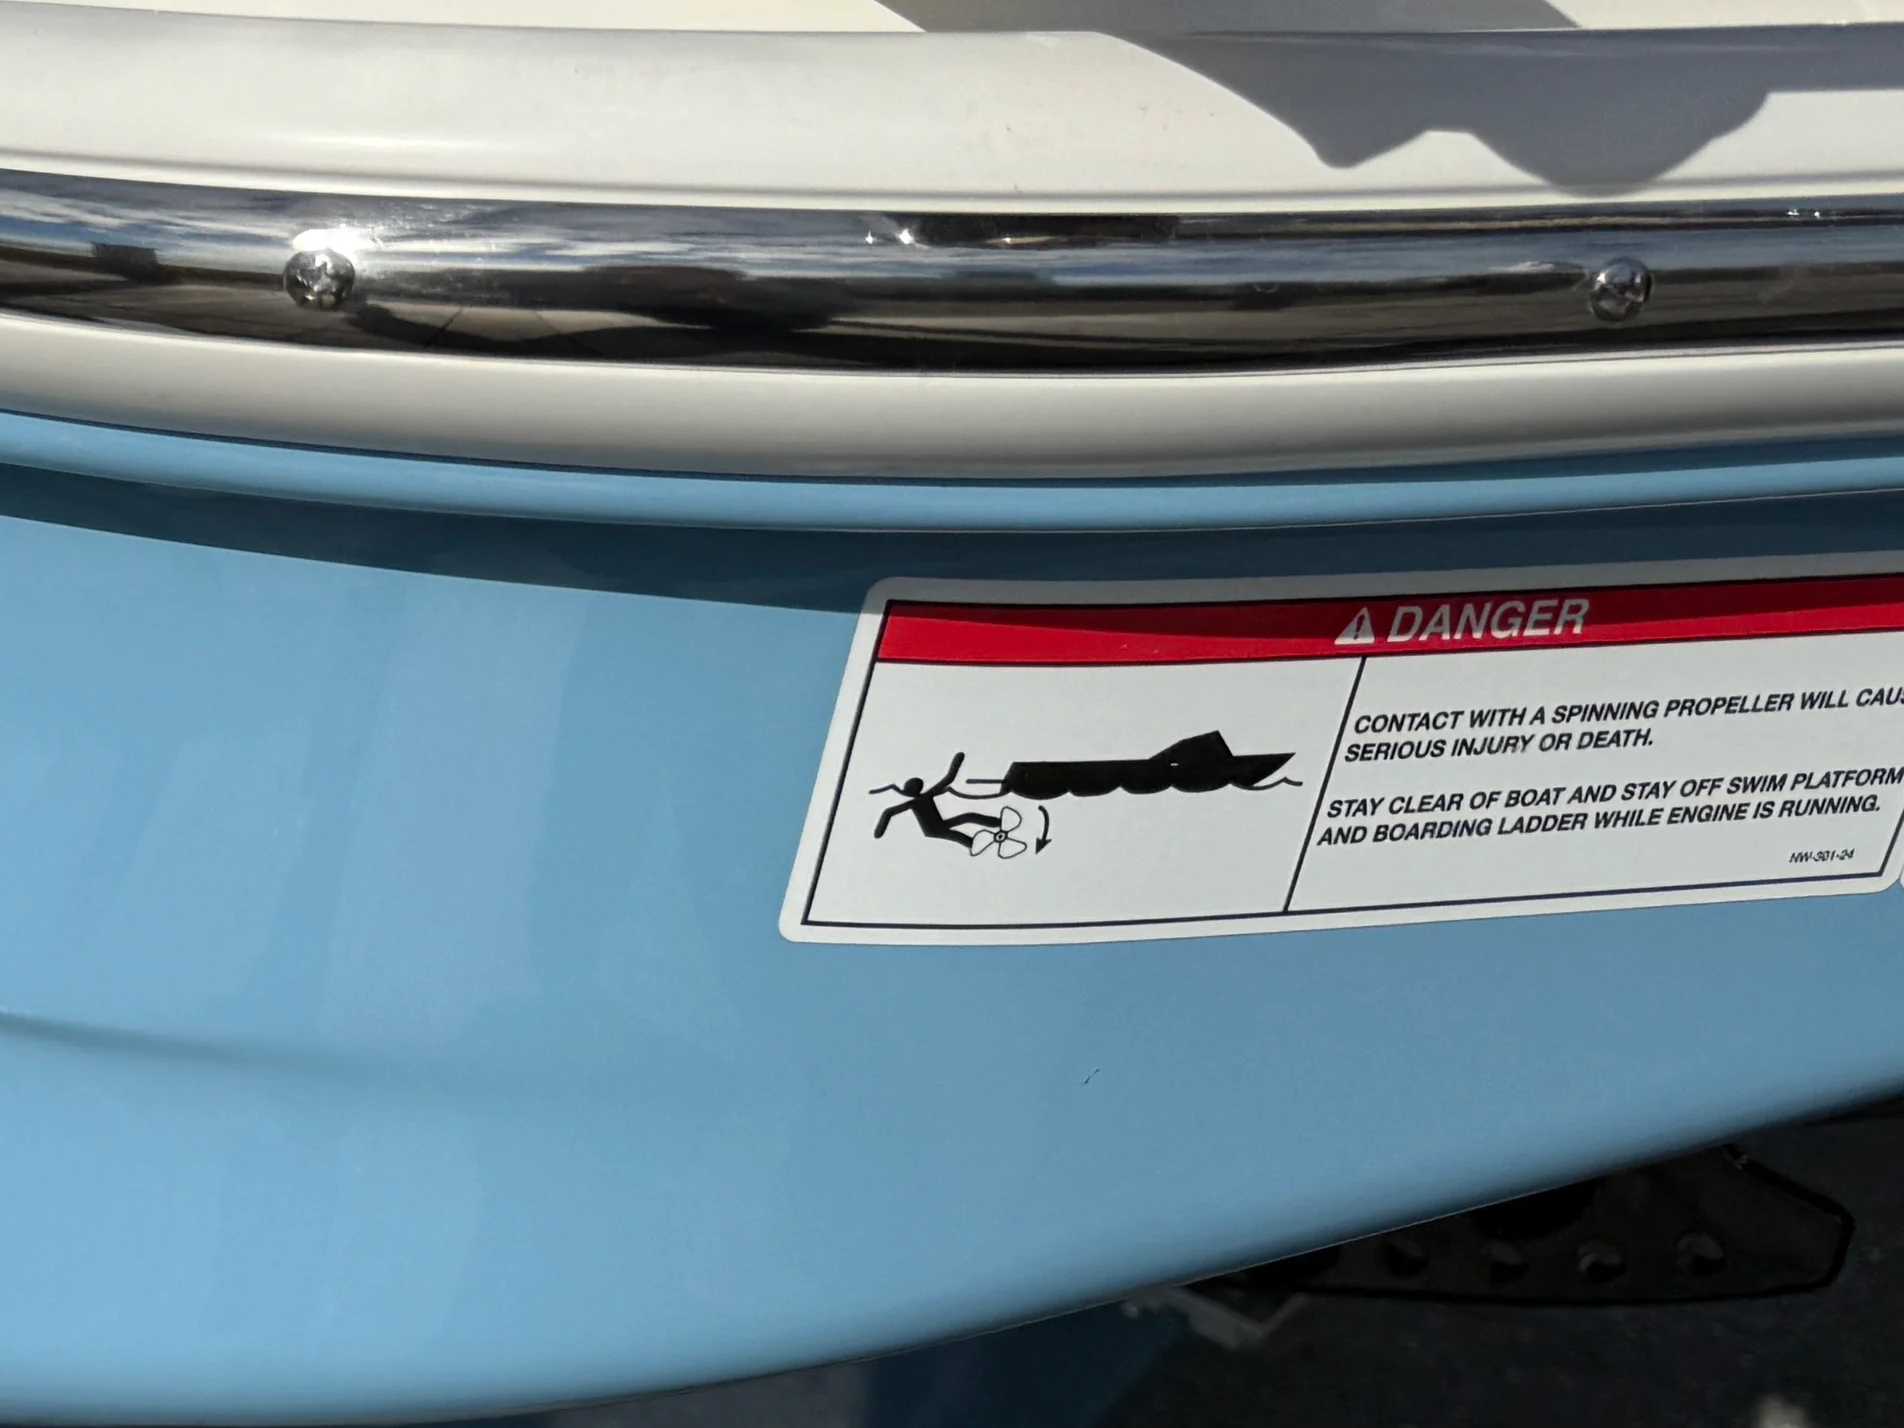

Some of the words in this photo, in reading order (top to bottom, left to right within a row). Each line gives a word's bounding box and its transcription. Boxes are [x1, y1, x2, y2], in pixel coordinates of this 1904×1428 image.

[1387, 598, 1590, 643] DANGER
[1354, 711, 1465, 734] CONTACT
[1469, 707, 1526, 728] WITH
[1530, 705, 1546, 725] A
[1551, 701, 1659, 723] SPINNING
[1663, 693, 1795, 718] PROPELLER
[1799, 690, 1849, 710] WILL
[1856, 685, 1904, 707] CAU
[1344, 739, 1446, 762] SERIOUS
[1451, 733, 1535, 757] INJURY
[1538, 732, 1572, 752] OR
[1577, 728, 1653, 750] DEATH.
[1327, 797, 1384, 819] STAY
[1388, 793, 1463, 815] CLEAR
[1469, 791, 1502, 810] OF
[1504, 787, 1566, 809] BOAT
[1567, 784, 1617, 805] AND
[1621, 780, 1677, 802] STAY
[1679, 777, 1724, 798] OFF
[1726, 773, 1788, 795] SWIM
[1791, 767, 1904, 791] PLATFORM
[1317, 826, 1366, 846] AND
[1372, 818, 1492, 844] BOARDING
[1497, 812, 1587, 836] LADDER
[1594, 808, 1664, 829] WHILE
[1666, 803, 1750, 825] ENGINE
[1753, 800, 1775, 819] IS
[1778, 794, 1881, 818] RUNNING.
